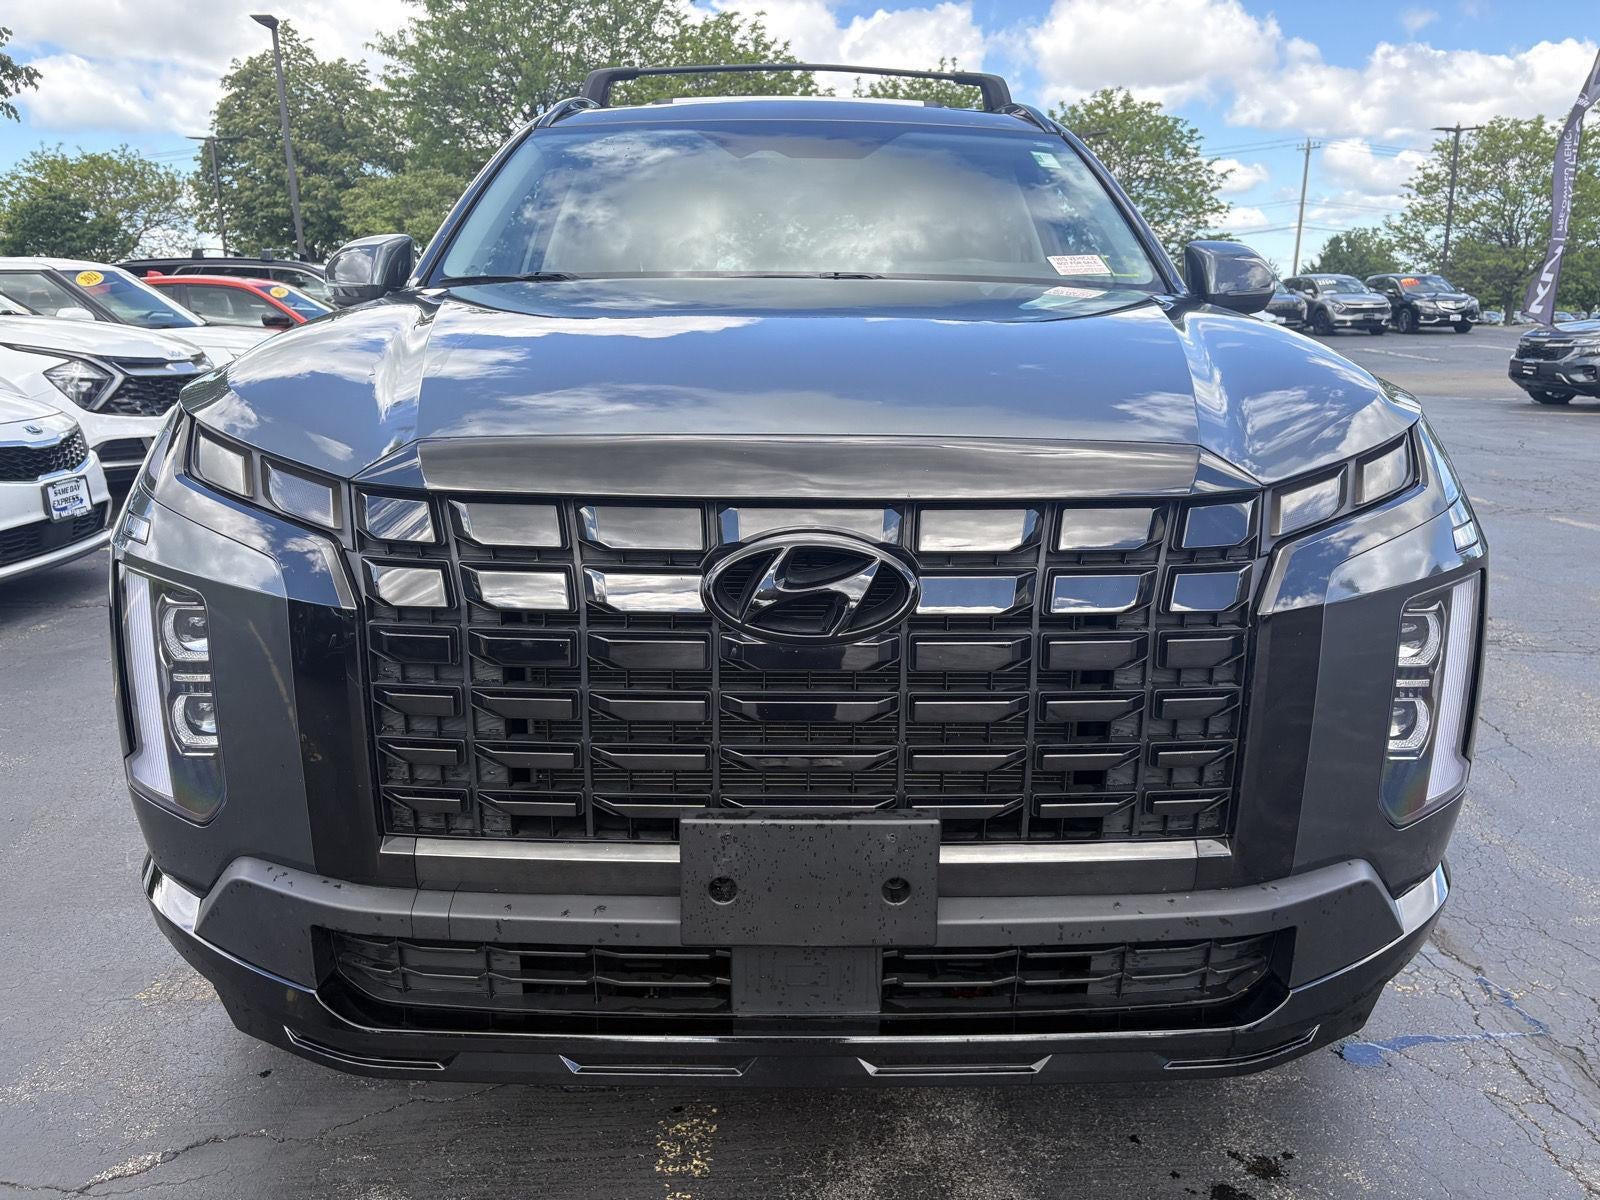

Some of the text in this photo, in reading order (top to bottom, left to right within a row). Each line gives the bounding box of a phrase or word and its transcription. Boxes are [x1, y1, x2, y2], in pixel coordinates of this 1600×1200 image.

[54, 483, 80, 496] SAME DAY
[52, 494, 80, 506] EXPRESS
